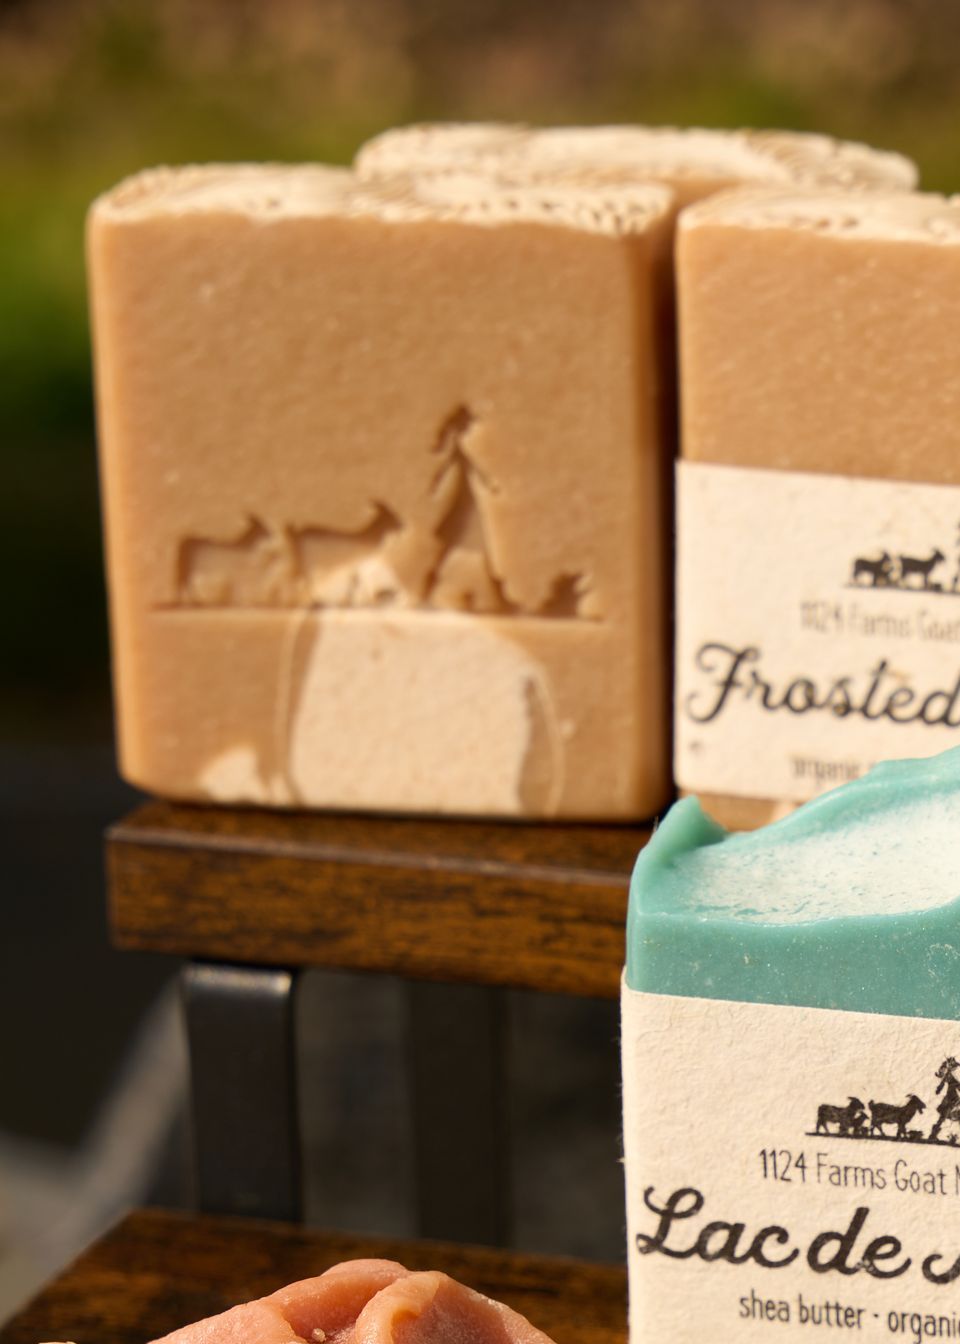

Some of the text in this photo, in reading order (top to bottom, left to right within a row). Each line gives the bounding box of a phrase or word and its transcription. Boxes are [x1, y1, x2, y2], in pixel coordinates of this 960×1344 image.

[760, 1149, 807, 1184] 1124
[815, 1153, 886, 1190] Farms
[893, 1159, 947, 1196] Goat
[635, 1185, 800, 1270] Lac
[804, 1206, 912, 1281] de
[739, 1290, 791, 1324] shea
[798, 1293, 867, 1331] butter
